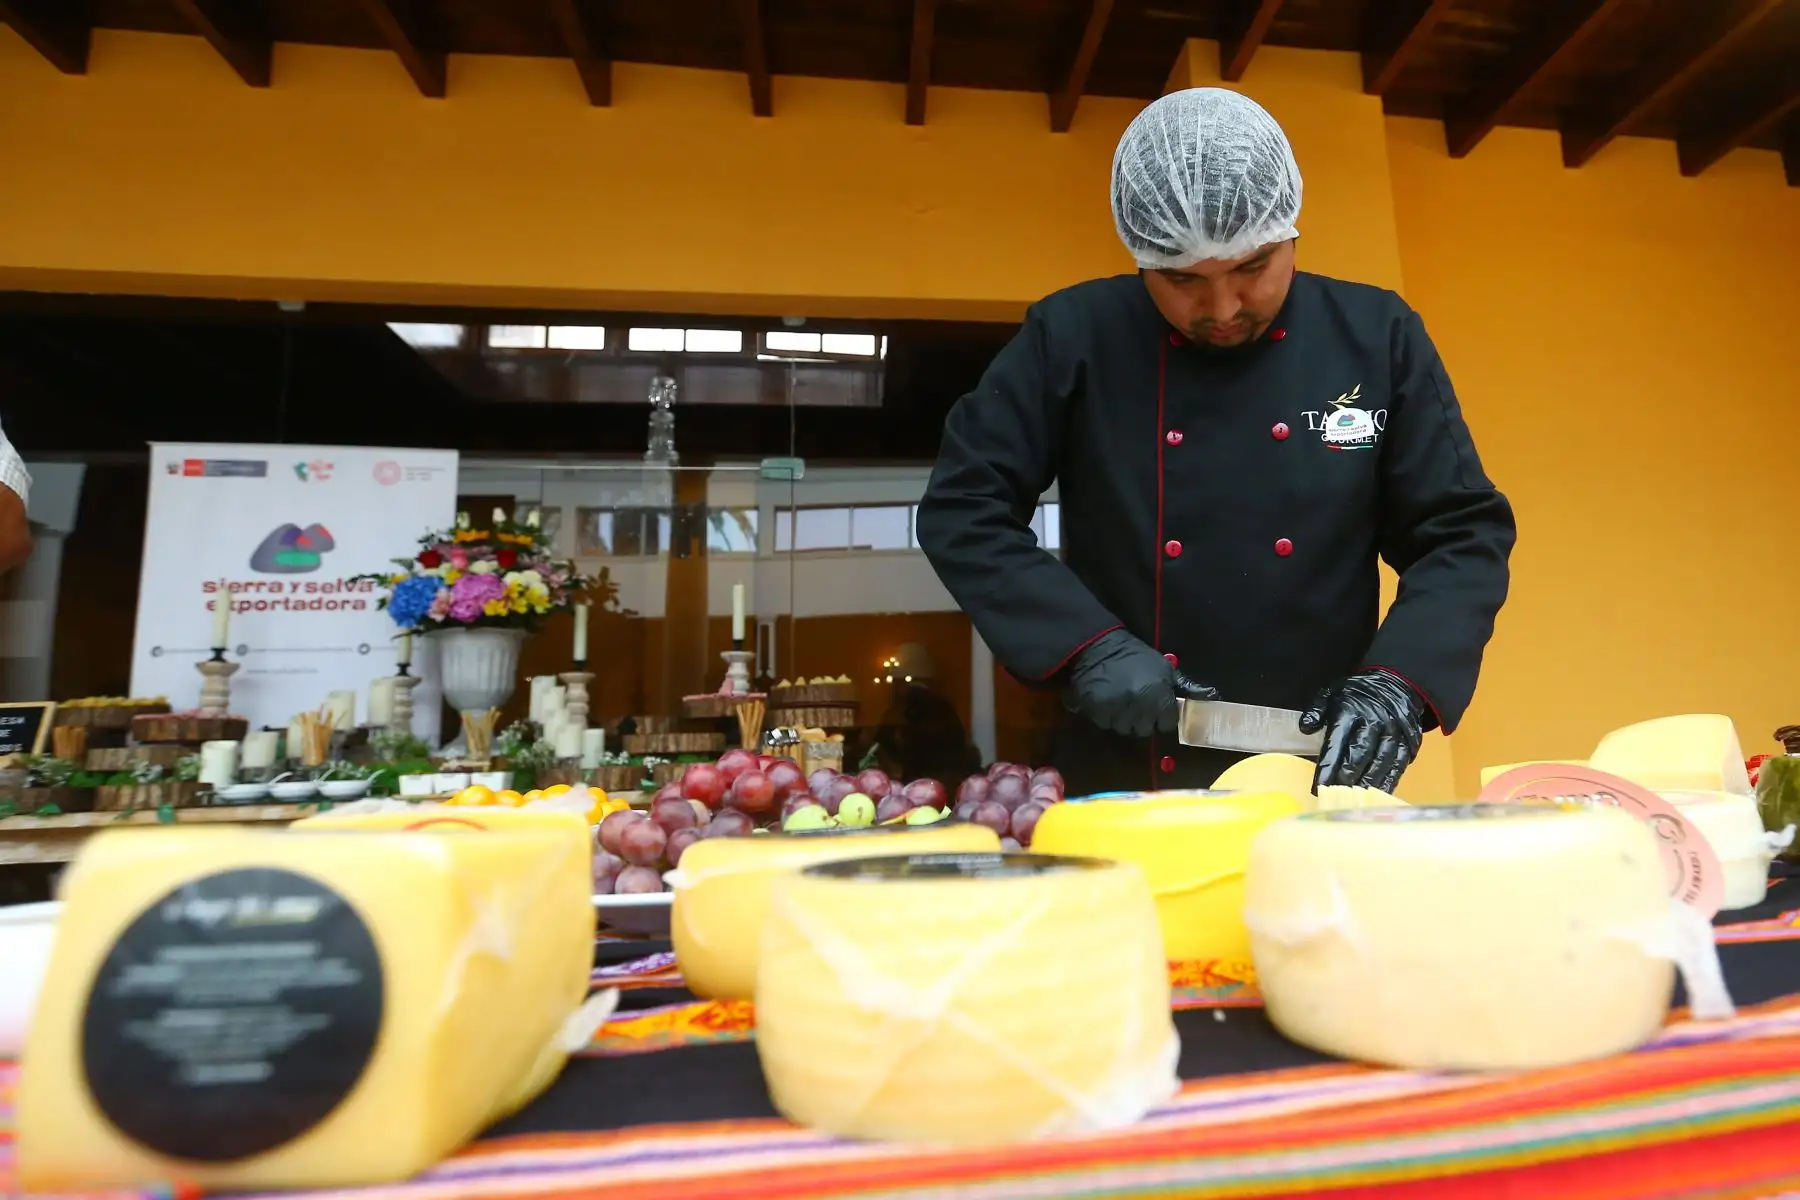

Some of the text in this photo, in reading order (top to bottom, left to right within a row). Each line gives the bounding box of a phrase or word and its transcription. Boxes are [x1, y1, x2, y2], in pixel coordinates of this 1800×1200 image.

[202, 578, 374, 594] sierra y selva
